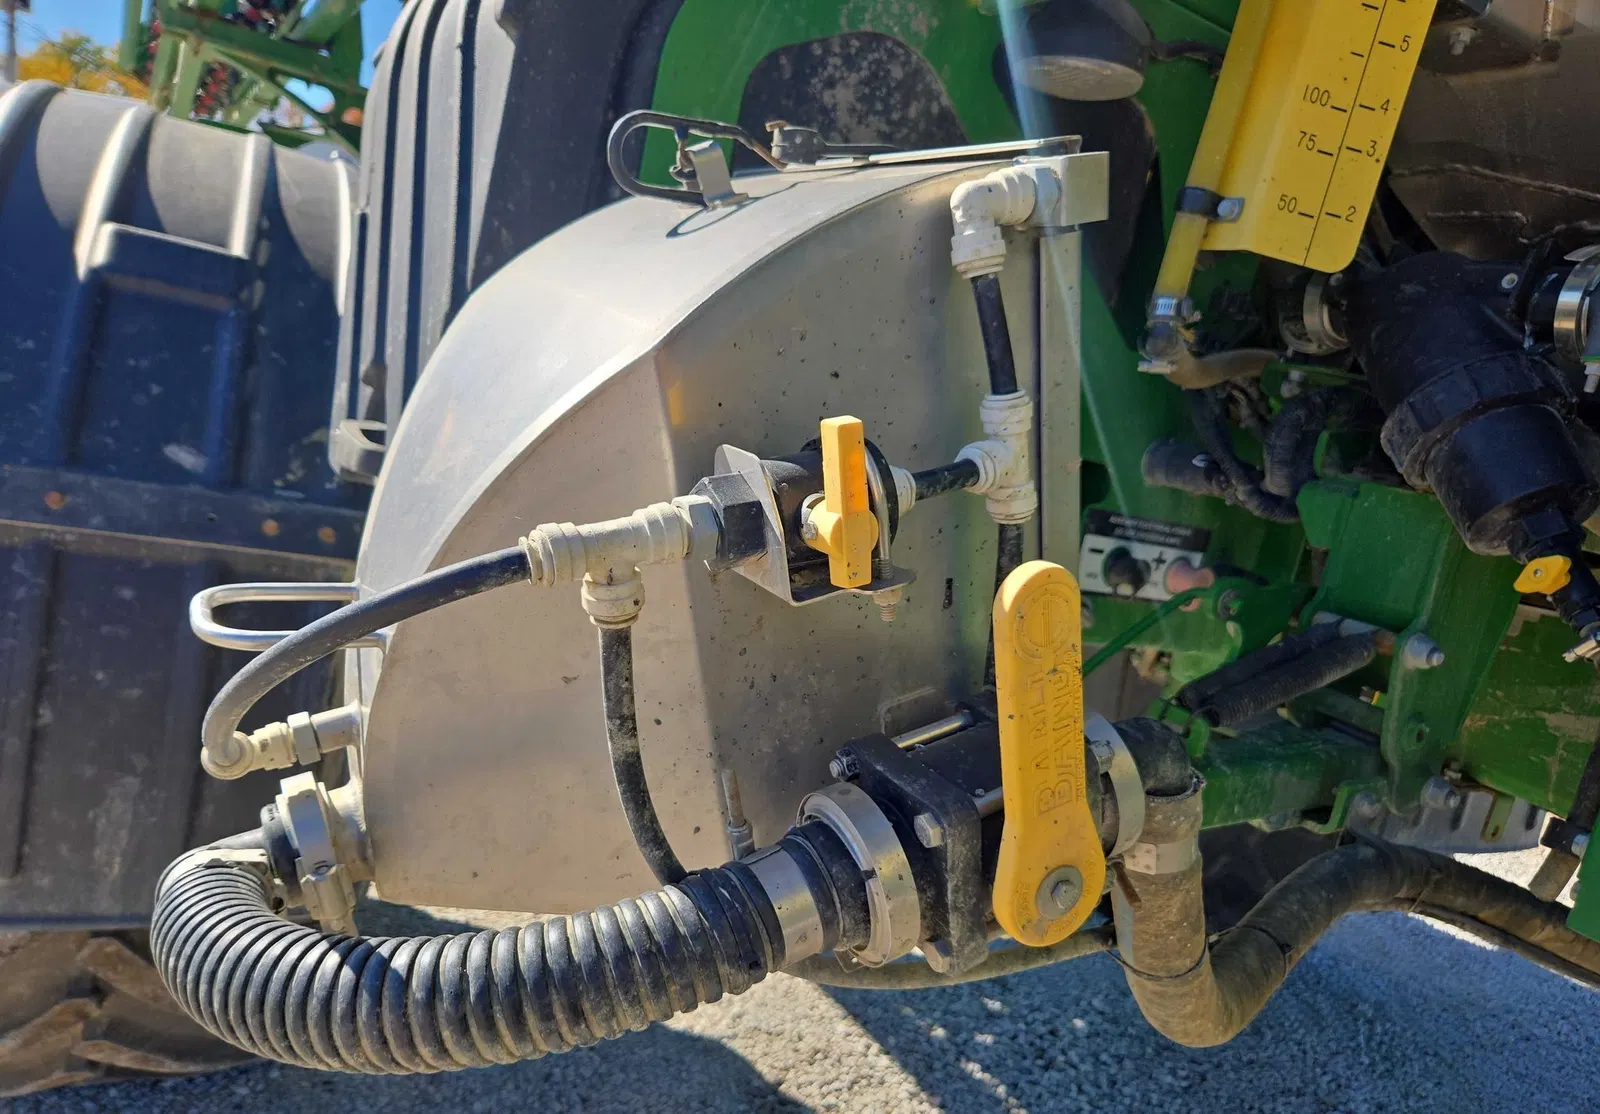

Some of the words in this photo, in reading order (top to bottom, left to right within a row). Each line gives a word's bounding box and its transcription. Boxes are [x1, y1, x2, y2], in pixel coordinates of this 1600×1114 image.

[1400, 34, 1412, 52] 5
[1302, 84, 1331, 107] 100
[1380, 98, 1391, 116] 4
[1297, 130, 1317, 151] 75
[1366, 140, 1378, 157] 3
[1277, 193, 1298, 214] 50
[1345, 205, 1357, 223] 2
